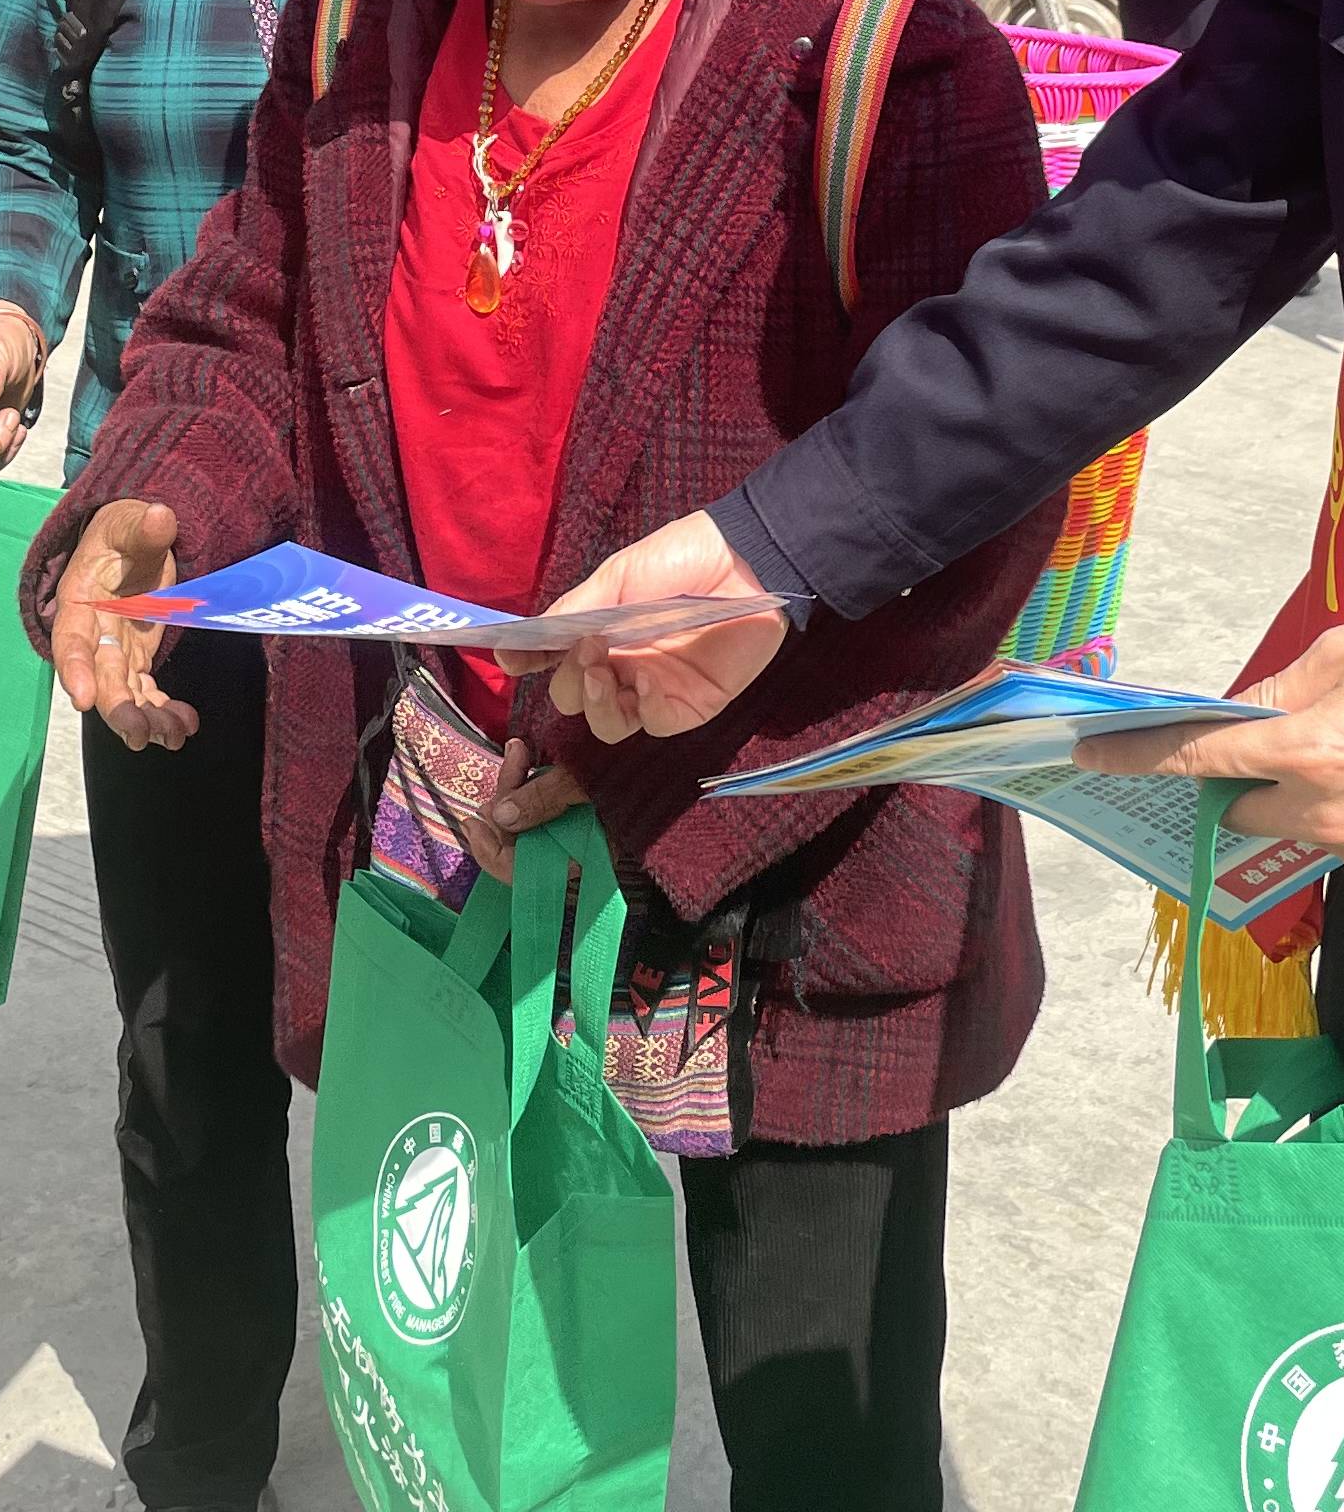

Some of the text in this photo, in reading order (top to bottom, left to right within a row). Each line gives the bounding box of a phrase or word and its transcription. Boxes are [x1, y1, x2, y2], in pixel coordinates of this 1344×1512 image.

[381, 1172, 396, 1219] CHINA
[381, 1228, 392, 1286] FOREST
[387, 1290, 407, 1320] FIRE
